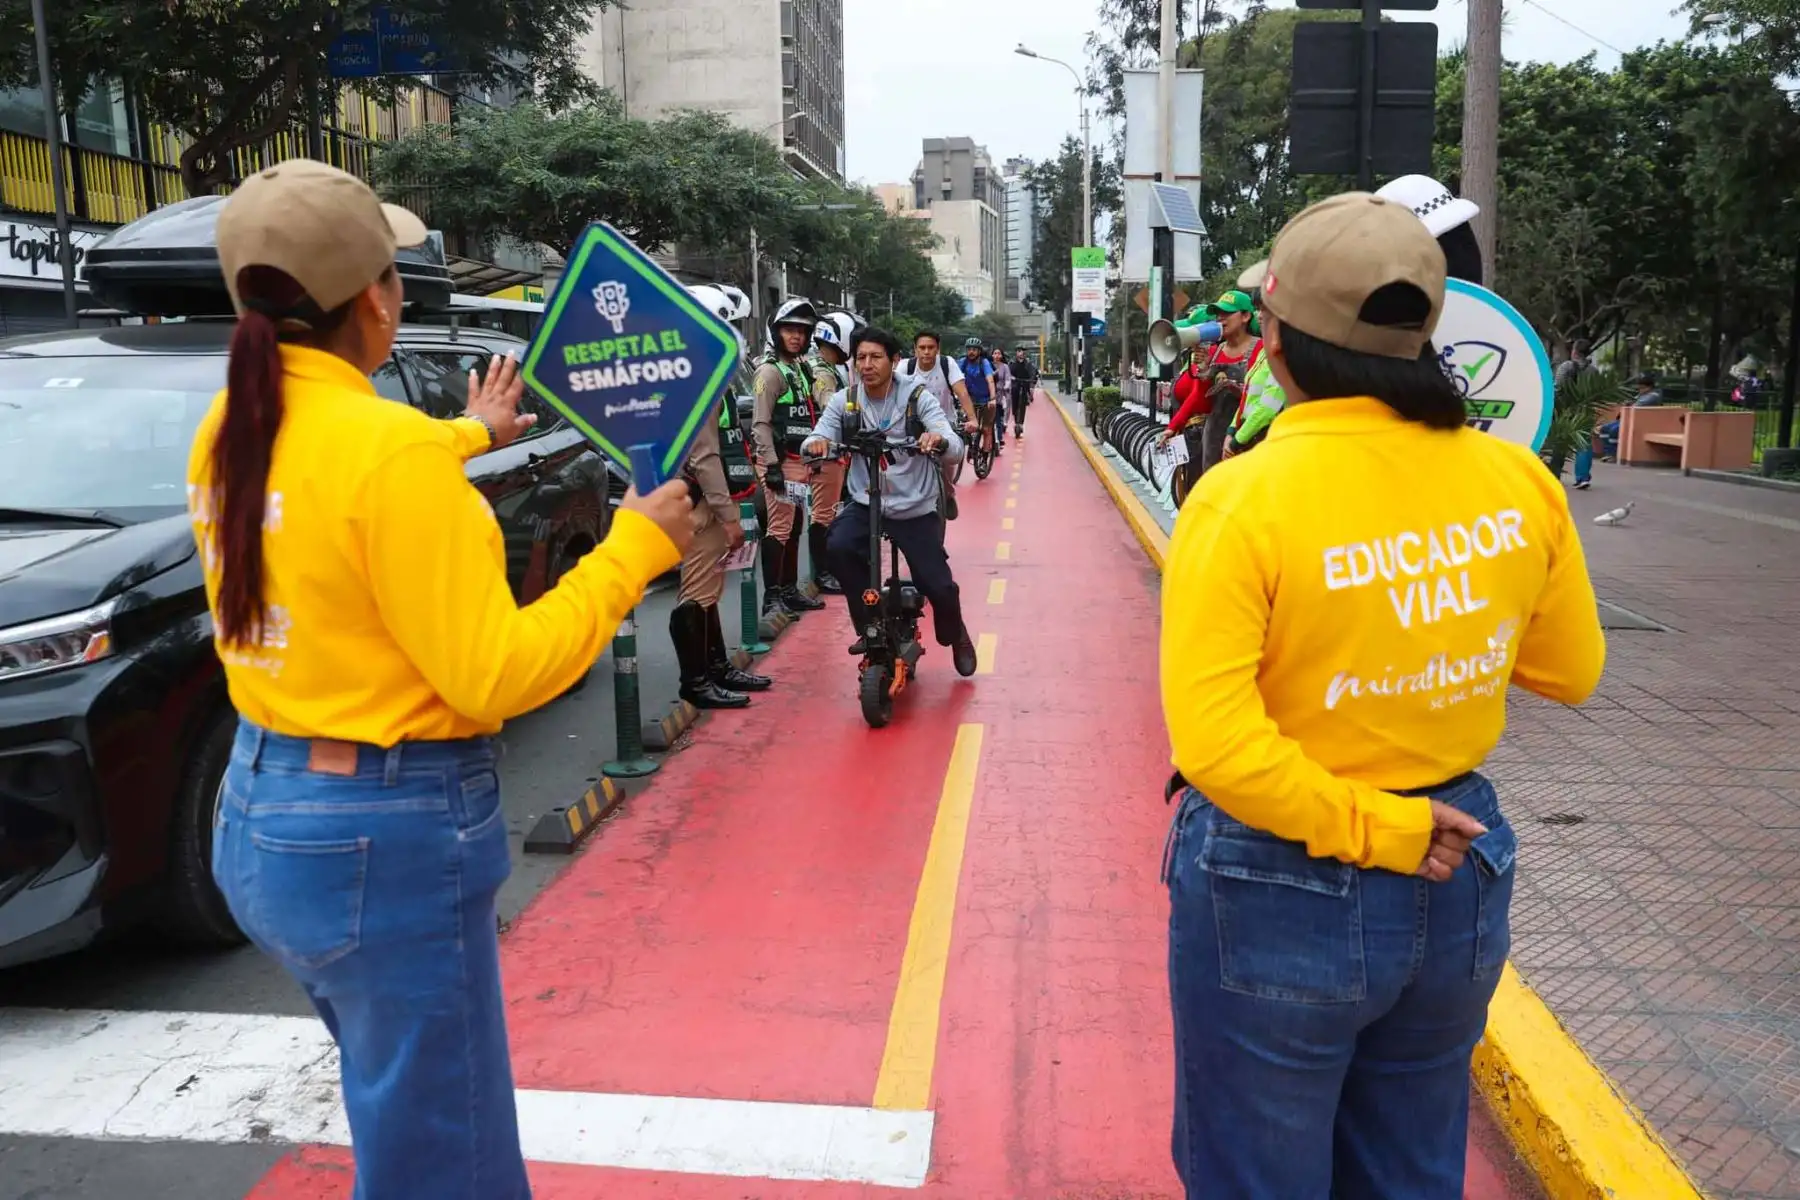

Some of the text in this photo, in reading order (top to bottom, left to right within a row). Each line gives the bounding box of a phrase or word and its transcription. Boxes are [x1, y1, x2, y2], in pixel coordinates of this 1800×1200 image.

[2, 224, 85, 276] topitp
[562, 328, 688, 367] RESPETA EL
[567, 356, 693, 392] SEMÁFORO
[1323, 508, 1529, 590] EDUCADOR
[1386, 570, 1490, 629] VIAL
[1324, 646, 1508, 710] miraflores
